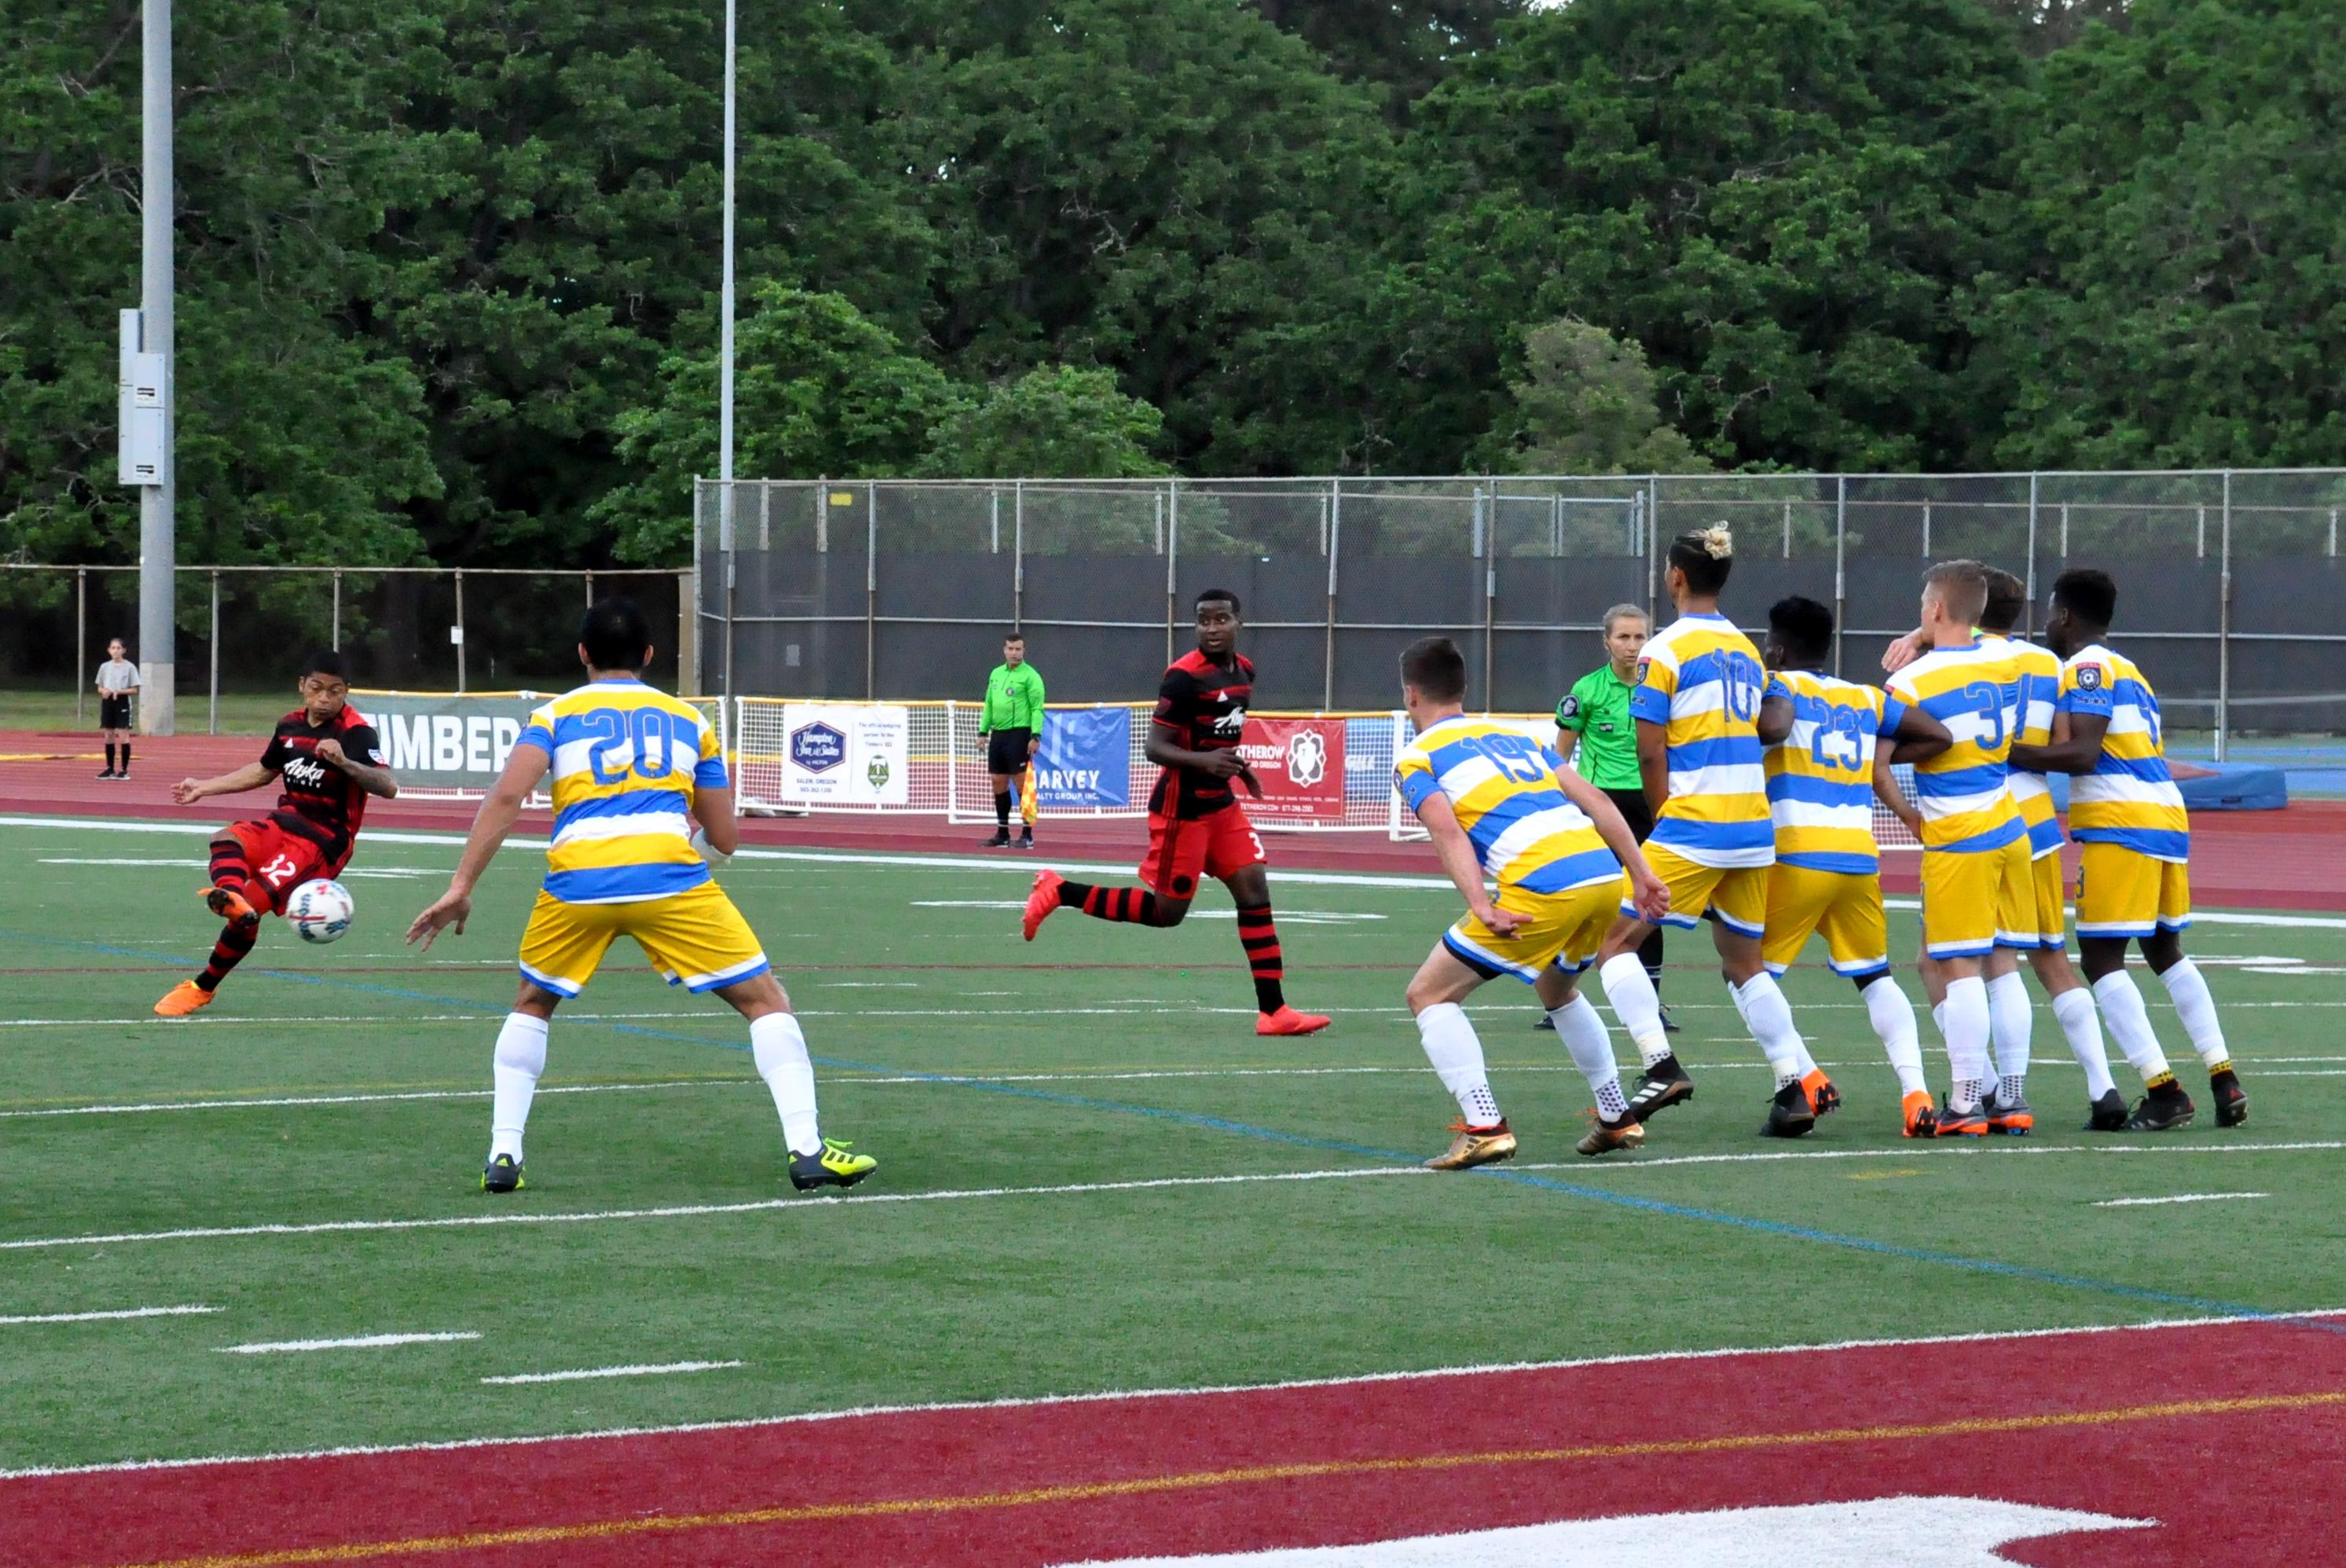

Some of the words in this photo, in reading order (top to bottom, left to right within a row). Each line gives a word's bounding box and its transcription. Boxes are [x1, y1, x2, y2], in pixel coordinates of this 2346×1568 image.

[1711, 648, 1753, 722] 10
[361, 713, 522, 773] IMBER
[797, 731, 837, 746] Hampton
[1810, 696, 1862, 771] 23
[1965, 681, 2004, 750] 3
[582, 707, 673, 786] 20
[1236, 744, 1285, 760] THEROW
[1460, 733, 1545, 784] 19
[1248, 832, 1265, 859] 3
